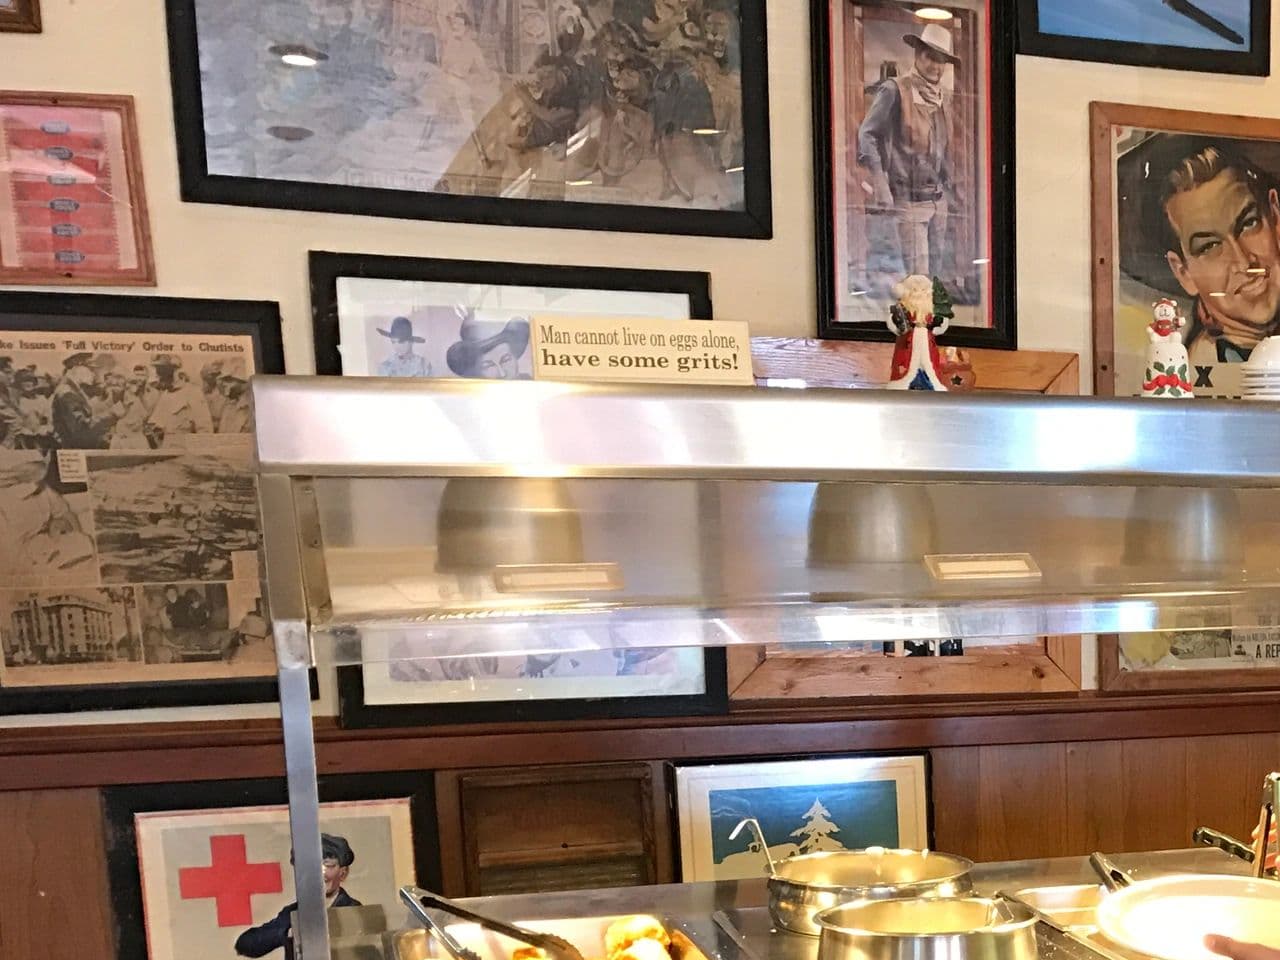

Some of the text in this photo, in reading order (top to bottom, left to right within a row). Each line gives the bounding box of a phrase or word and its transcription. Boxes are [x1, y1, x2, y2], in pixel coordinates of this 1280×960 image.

[19, 339, 56, 350] Issues
[142, 341, 175, 351] Order
[181, 342, 193, 352] to
[199, 341, 245, 353] Chutists
[540, 325, 740, 351] Man cannot live on eggs alone,
[542, 349, 739, 373] have some grits!
[1255, 644, 1262, 658] A
